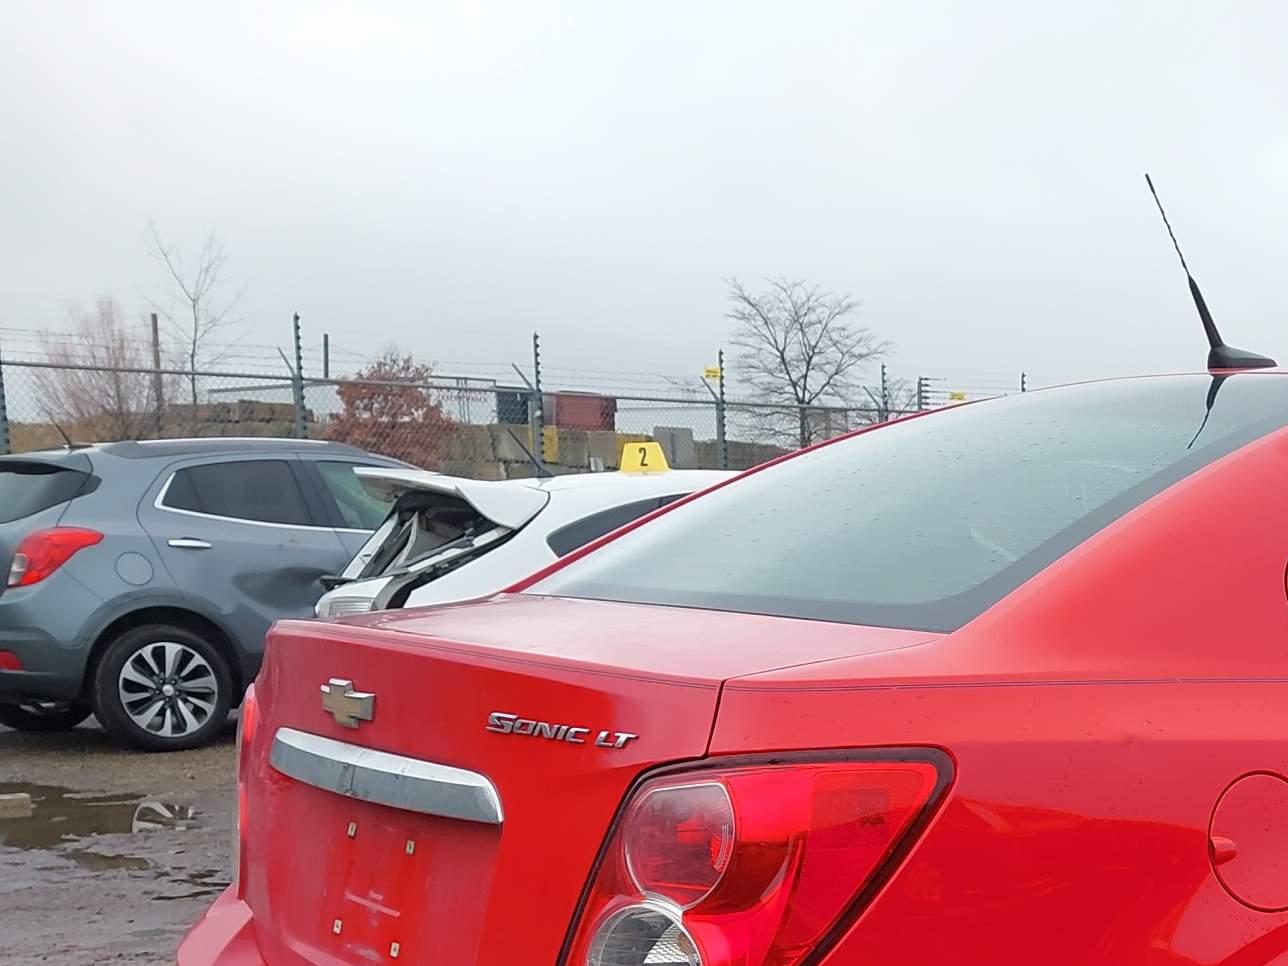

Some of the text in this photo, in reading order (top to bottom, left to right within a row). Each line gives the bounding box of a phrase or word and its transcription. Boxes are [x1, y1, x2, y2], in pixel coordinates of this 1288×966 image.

[638, 446, 649, 467] 2
[485, 711, 639, 749] SONIC LT
